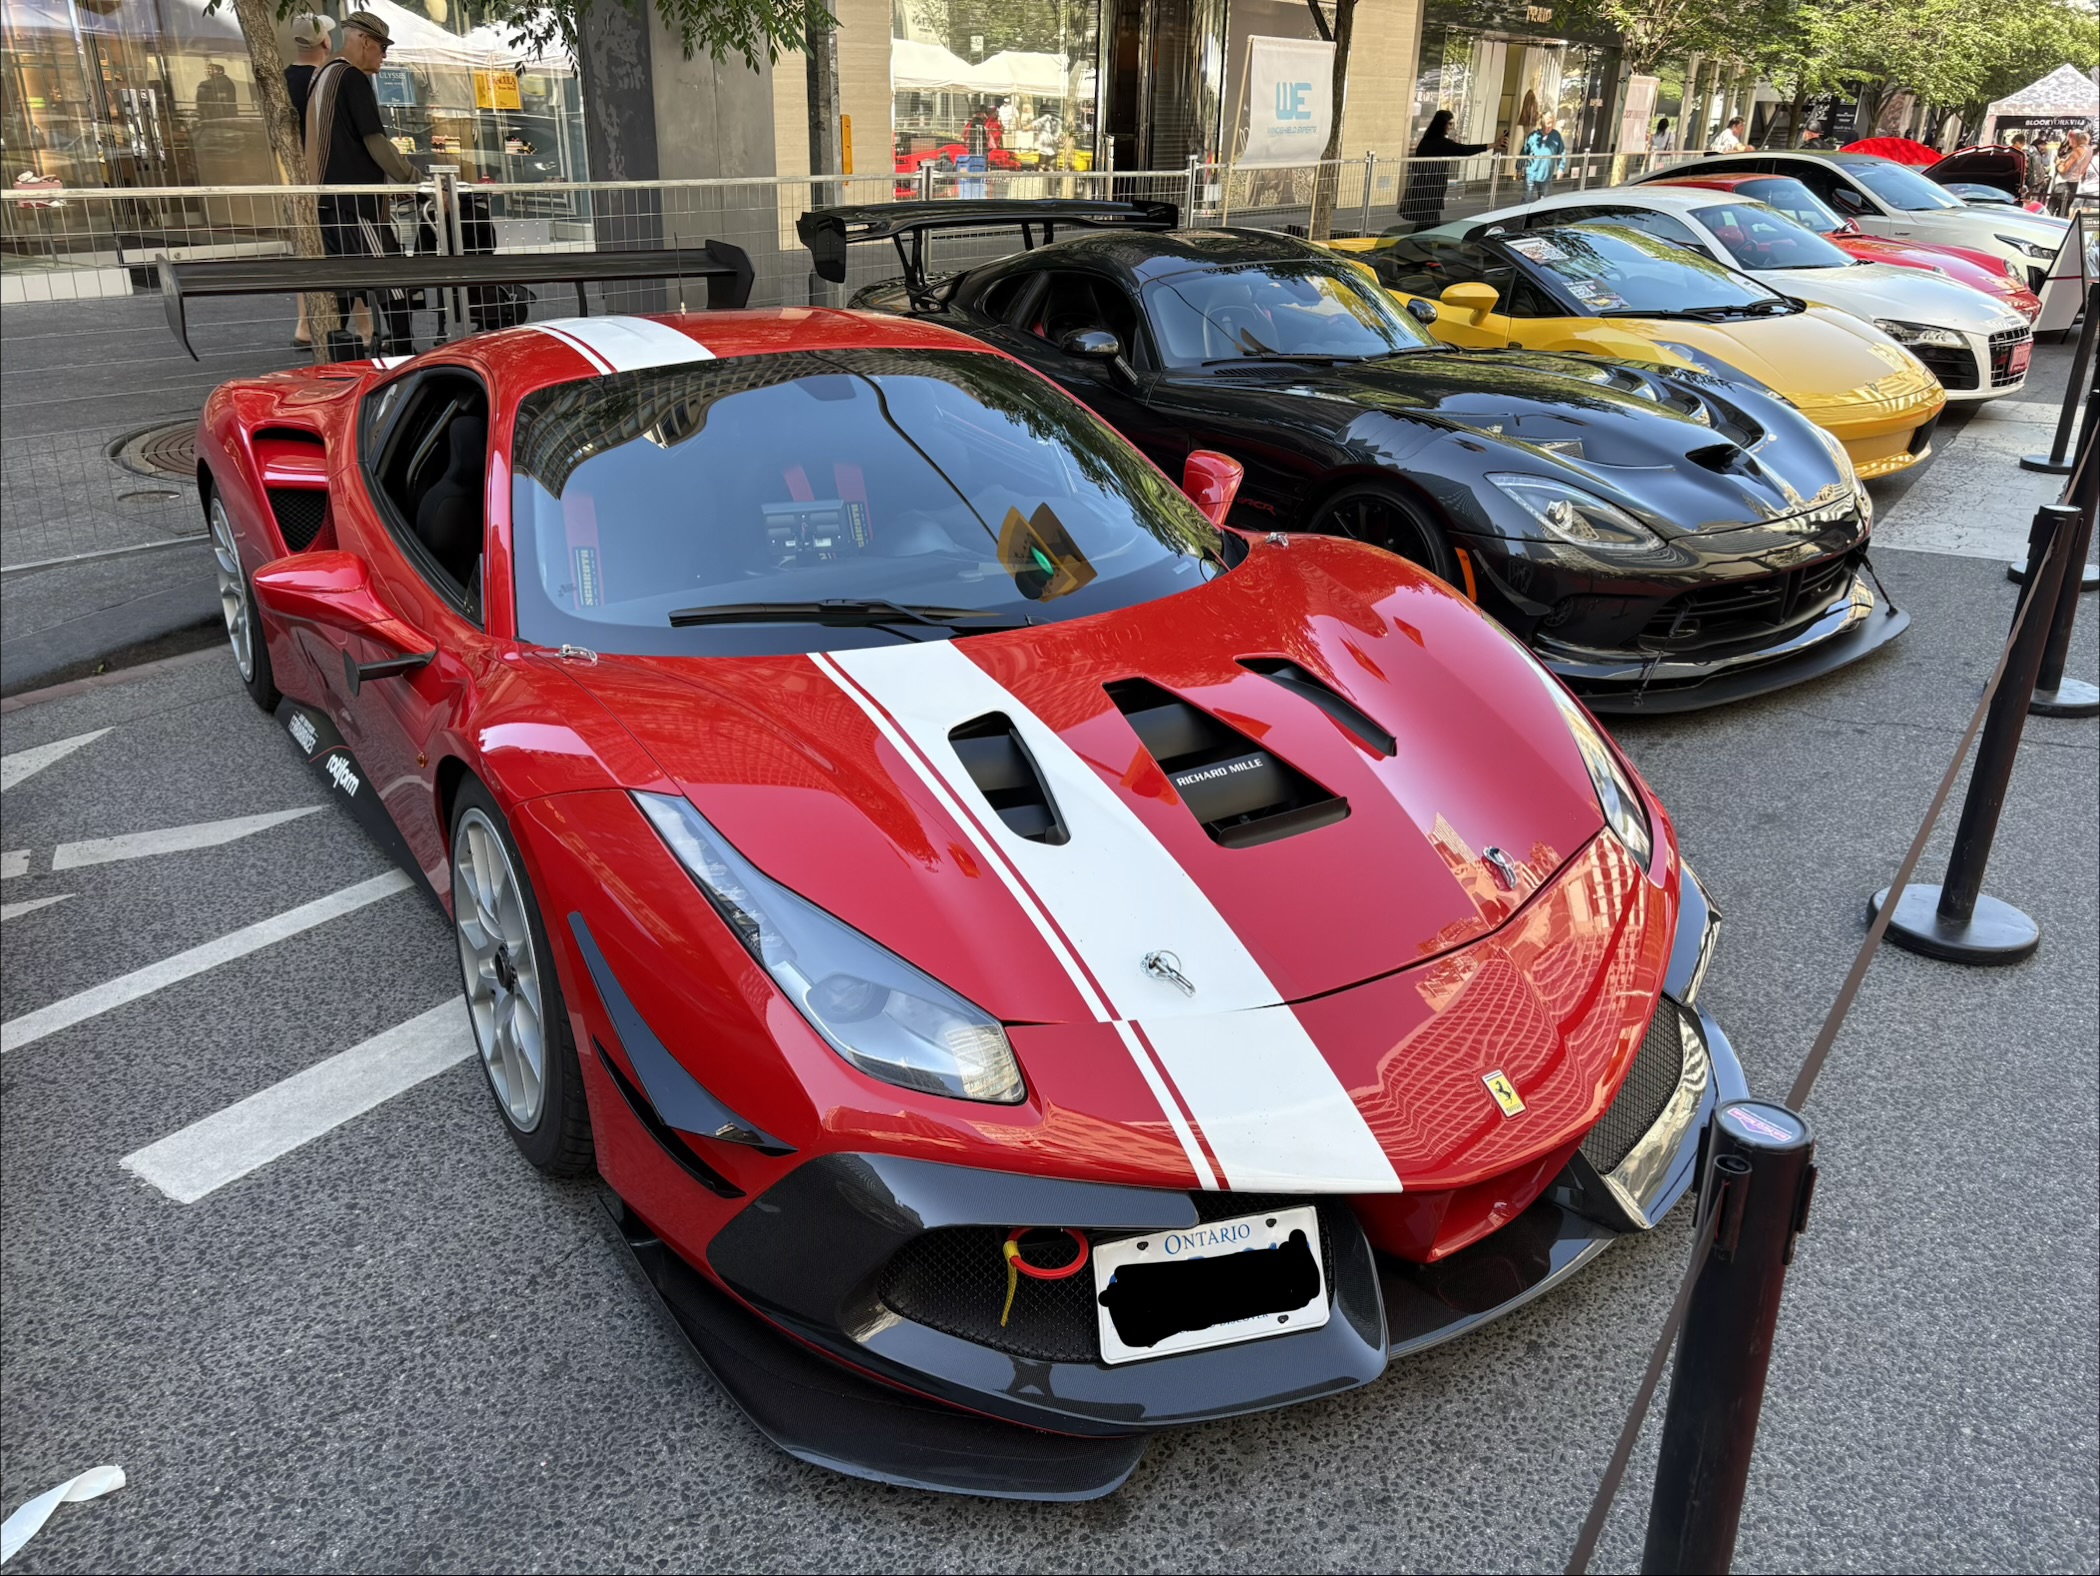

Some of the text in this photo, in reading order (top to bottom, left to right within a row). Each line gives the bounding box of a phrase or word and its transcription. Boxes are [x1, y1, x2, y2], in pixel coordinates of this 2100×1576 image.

[378, 71, 406, 79] ULYSSES
[1275, 81, 1313, 120] WE
[580, 549, 594, 606] SCHROTH
[325, 754, 359, 797] rotiform
[1176, 758, 1264, 787] RICHARD MILLE
[1164, 1223, 1250, 1255] ONTARIO
